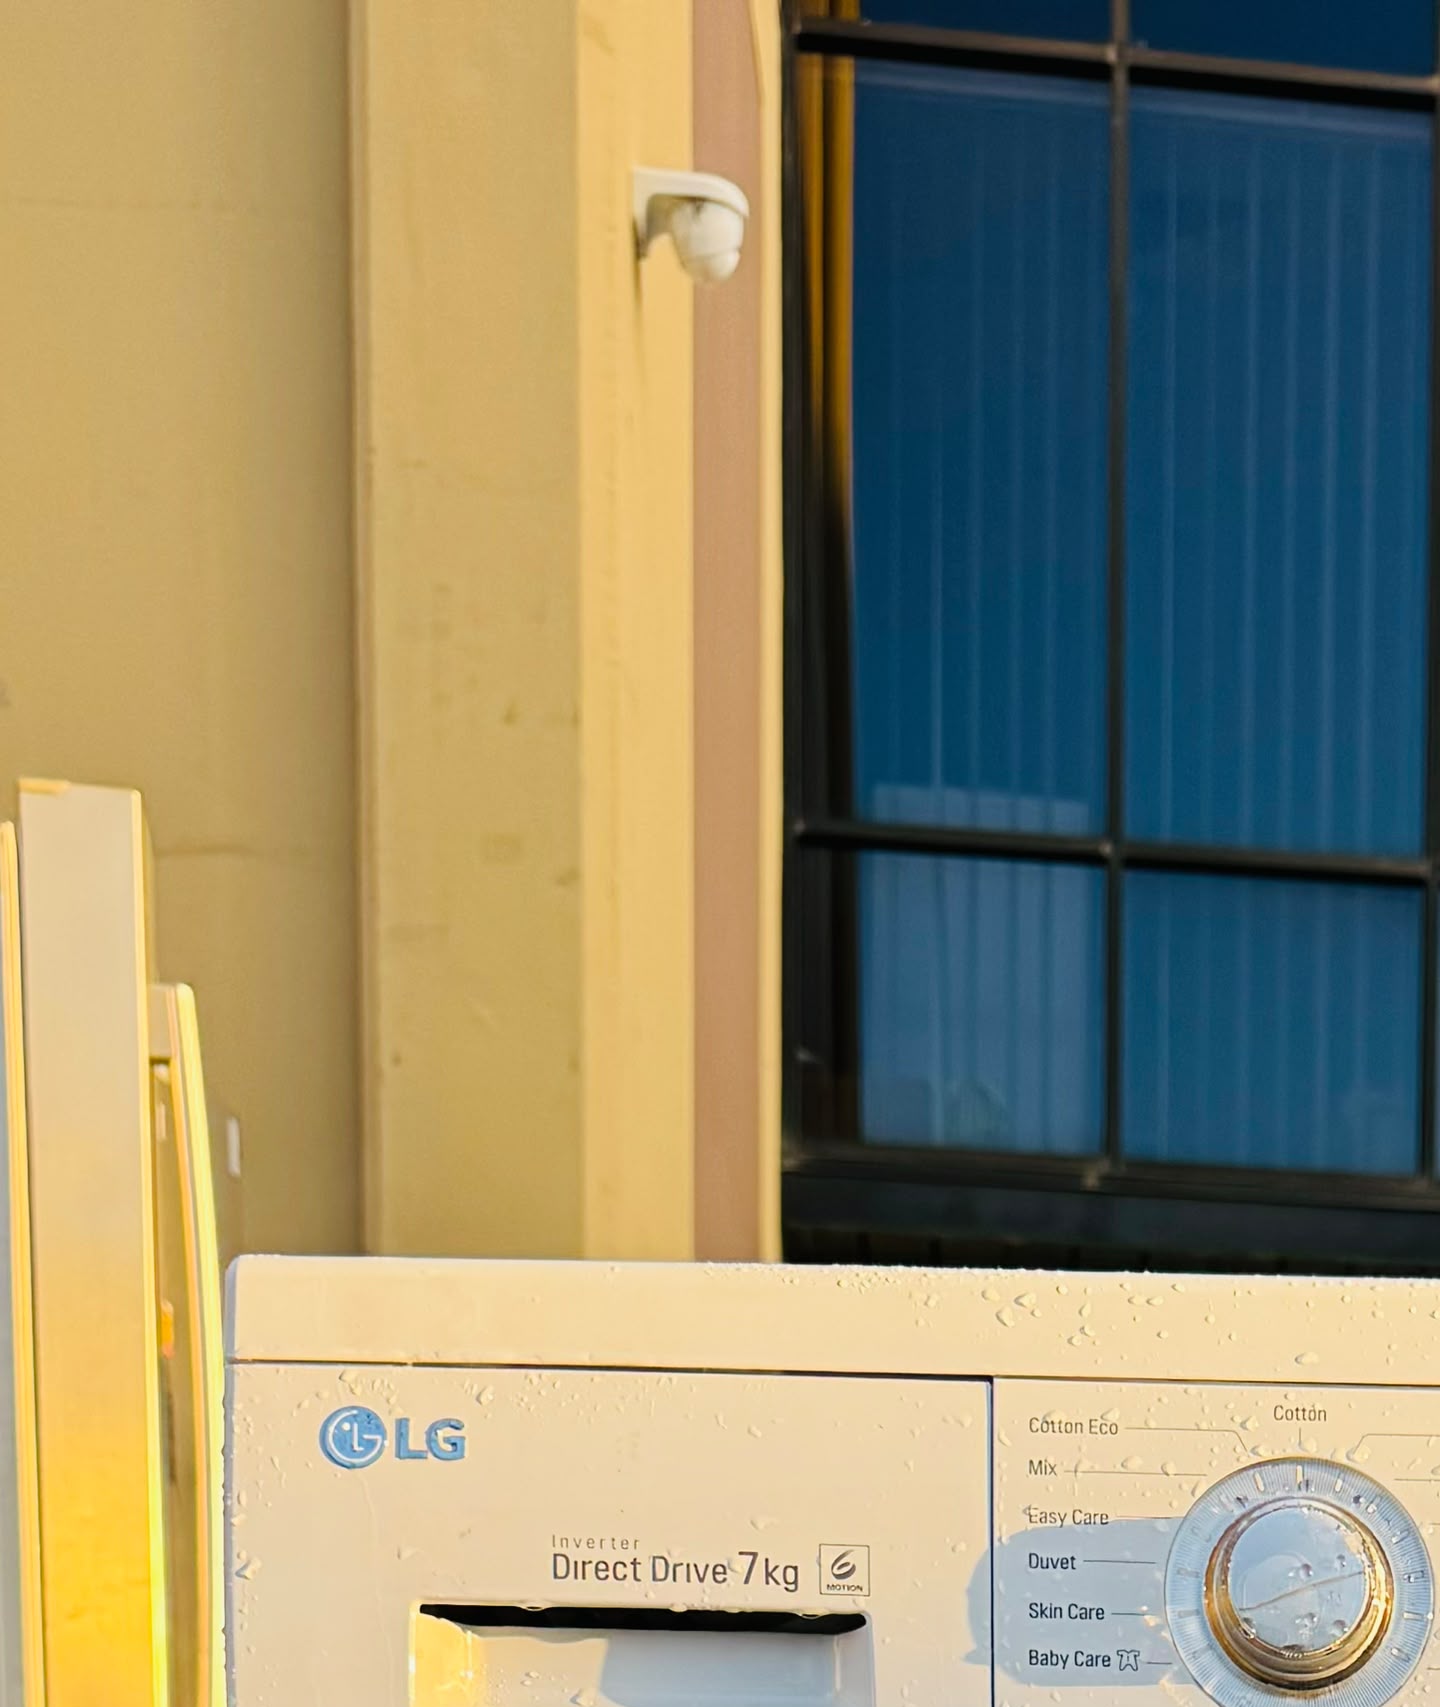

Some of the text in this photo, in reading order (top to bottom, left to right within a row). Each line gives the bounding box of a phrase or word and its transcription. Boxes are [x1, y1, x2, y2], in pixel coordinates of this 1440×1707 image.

[1273, 1405, 1327, 1422] Cotton
[1028, 1418, 1119, 1435] Cotton Eco
[395, 1418, 465, 1460] LG
[1028, 1460, 1057, 1476] Mix
[1028, 1509, 1109, 1526] Easy Care
[551, 1534, 640, 1550] Inverter
[552, 1552, 642, 1582] Direct
[651, 1555, 728, 1584] Drive
[1028, 1552, 1076, 1570] Duvet
[826, 1583, 863, 1592] MOTION
[1028, 1602, 1105, 1620] Skin Care
[1028, 1649, 1111, 1669] Baby Care
